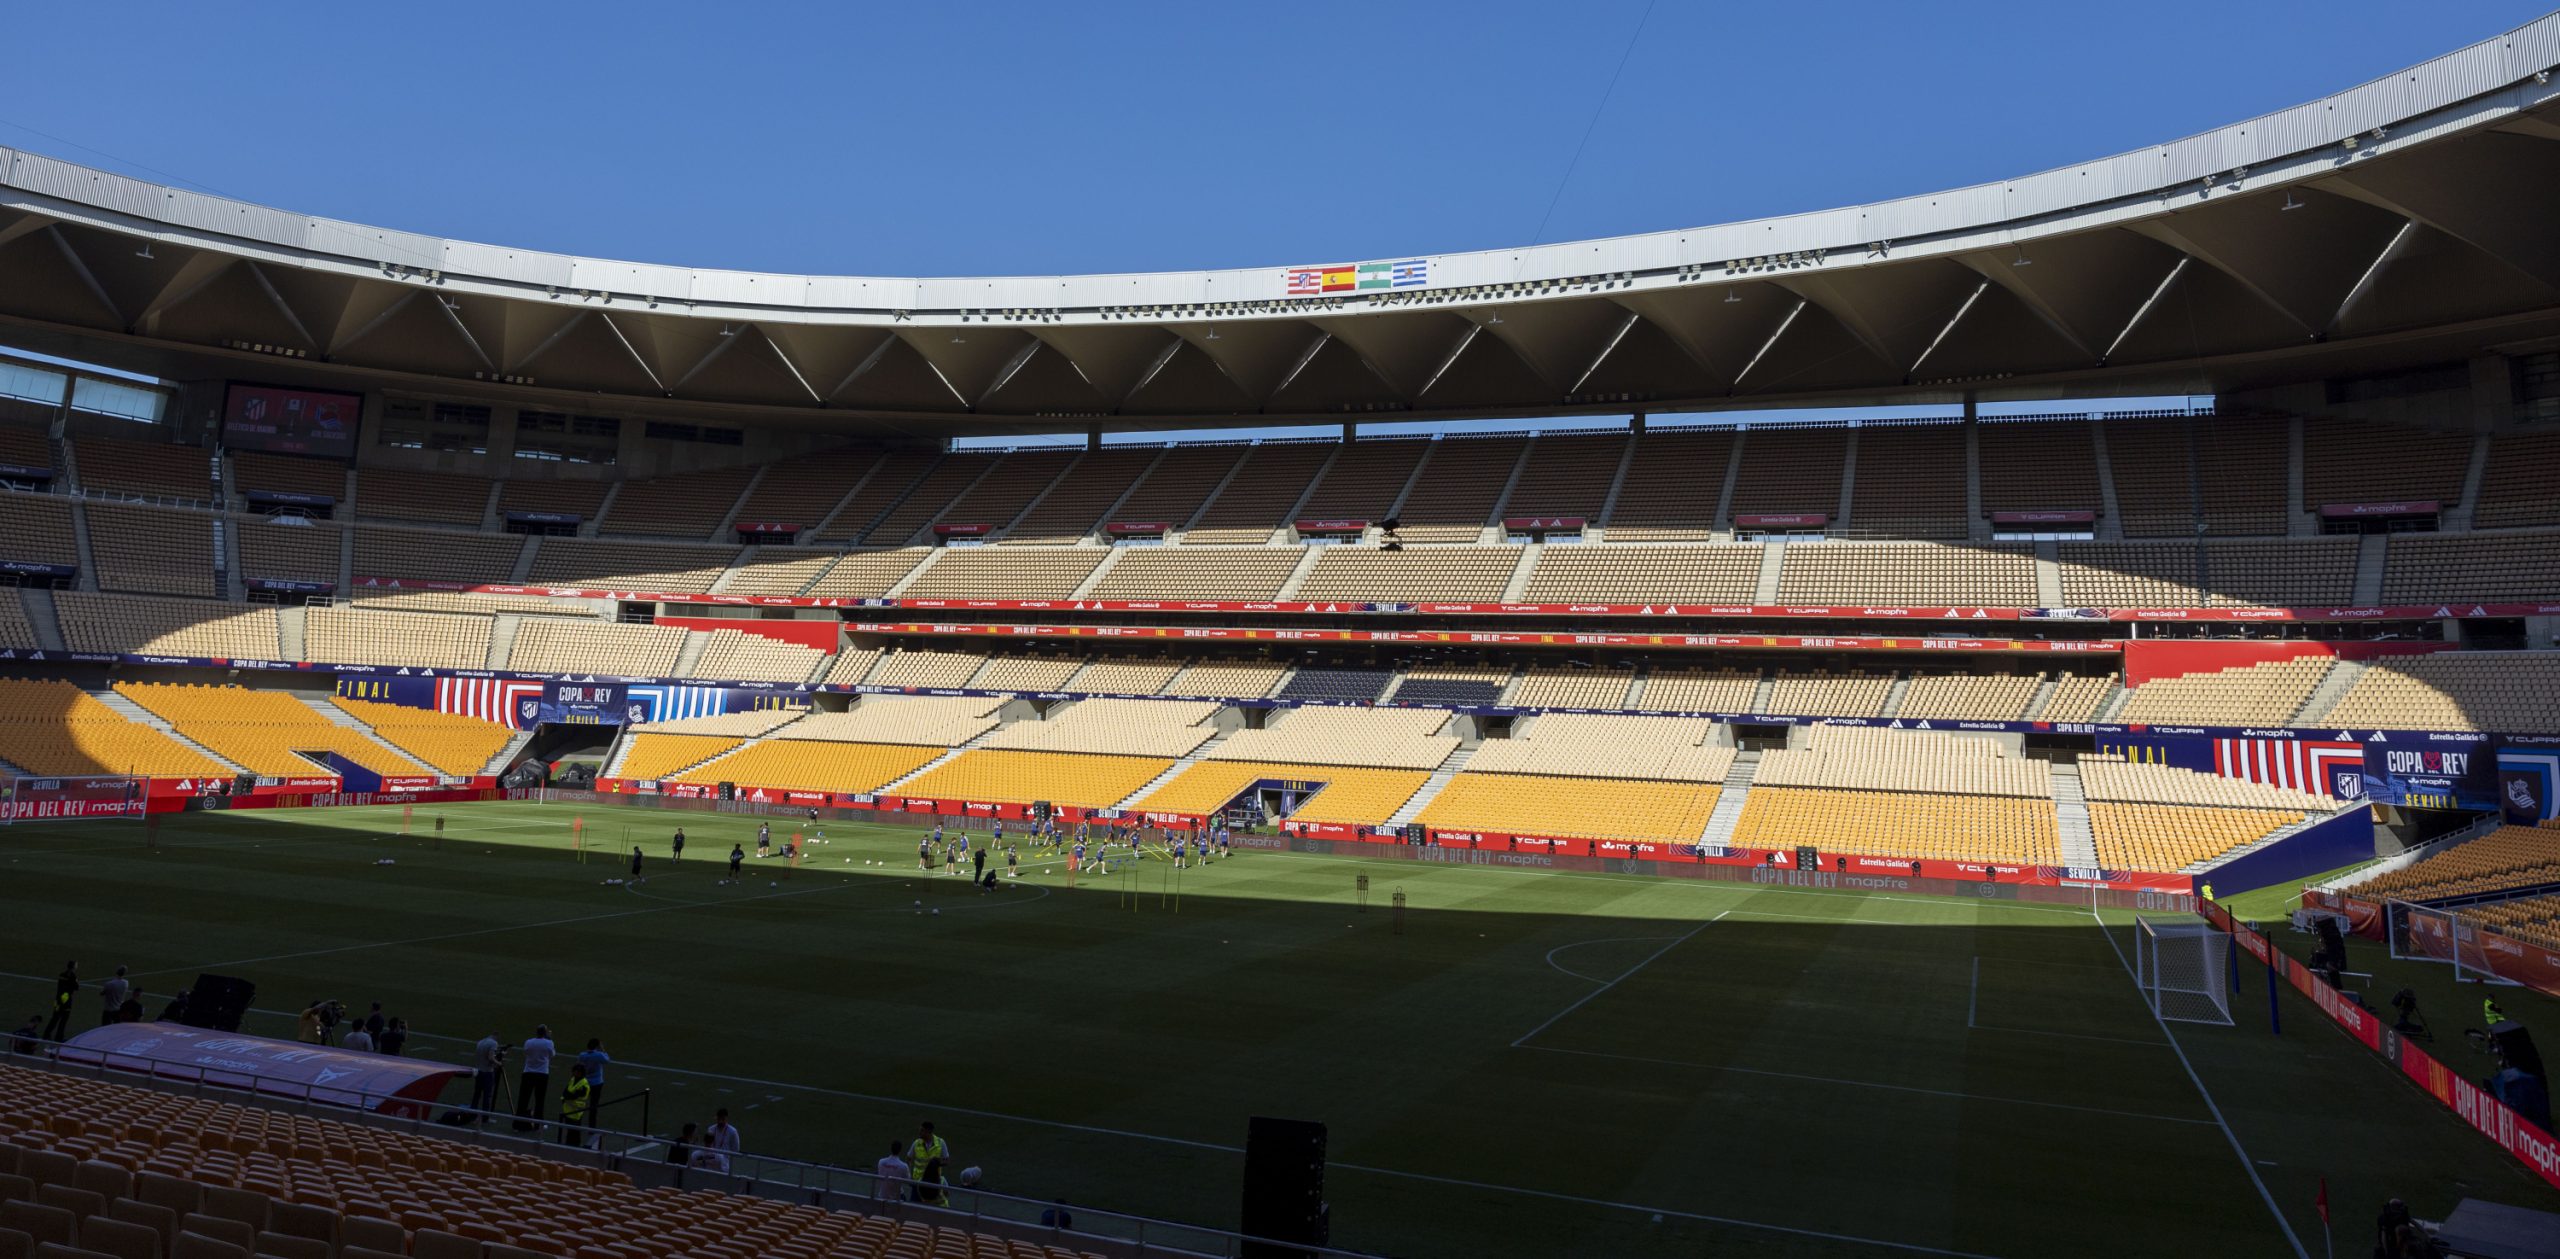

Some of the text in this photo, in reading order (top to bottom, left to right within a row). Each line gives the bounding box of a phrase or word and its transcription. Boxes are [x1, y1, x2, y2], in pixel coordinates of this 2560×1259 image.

[2368, 505, 2406, 513] mapfre
[17, 564, 52, 573] mapfre
[2345, 608, 2384, 617] mapfre
[1922, 640, 1936, 648] COPA
[2050, 642, 2065, 650] COPA
[234, 659, 247, 668] COPA
[248, 660, 257, 668] DEL
[258, 660, 268, 668] REY
[336, 680, 390, 698] FINAL
[559, 686, 612, 703] COPA REY
[566, 715, 600, 724] SEVILLA
[2057, 723, 2072, 732] COPA
[2074, 724, 2083, 733] DEL
[2084, 724, 2095, 733] REY
[2257, 730, 2295, 738] mapfre
[2104, 744, 2166, 766] FINAL
[2387, 751, 2468, 776] COPA REY
[32, 779, 60, 790] SEVILLA
[255, 776, 278, 786] SEVILLA
[1284, 780, 1306, 790] FINAL
[276, 792, 416, 808] FINAL COPA DEL REY mapfre
[507, 788, 525, 800] COPA
[563, 792, 596, 801] mapfre
[855, 794, 874, 803] SEVILLA
[717, 800, 736, 813] COPA
[738, 801, 751, 814] DEL
[754, 802, 768, 814] REY
[2405, 793, 2458, 809] SEVILLA
[1, 800, 144, 818] COPA DEL REY mapfre
[1099, 809, 1119, 818] SEVILLA
[944, 815, 966, 828] COPA
[968, 816, 983, 829] DEL
[1168, 814, 1177, 822] REY
[1285, 822, 1298, 831] COPA
[1310, 823, 1319, 831] REY
[1234, 836, 1280, 848] mapfre
[1418, 846, 1551, 866] COPA DEL REY mapfre
[1752, 867, 1784, 884] COPA
[1789, 870, 1810, 887] DEL
[1815, 871, 1837, 888] REY
[1846, 876, 1908, 889] mapfre
[2069, 867, 2101, 880] SEVILLA
[2137, 892, 2175, 911] COPA
[2340, 1003, 2361, 1030] mapfre
[2455, 1075, 2477, 1127] COPA
[2480, 1092, 2496, 1139] DEL
[2498, 1104, 2514, 1152] REY
[2519, 1129, 2560, 1176] mapfr
